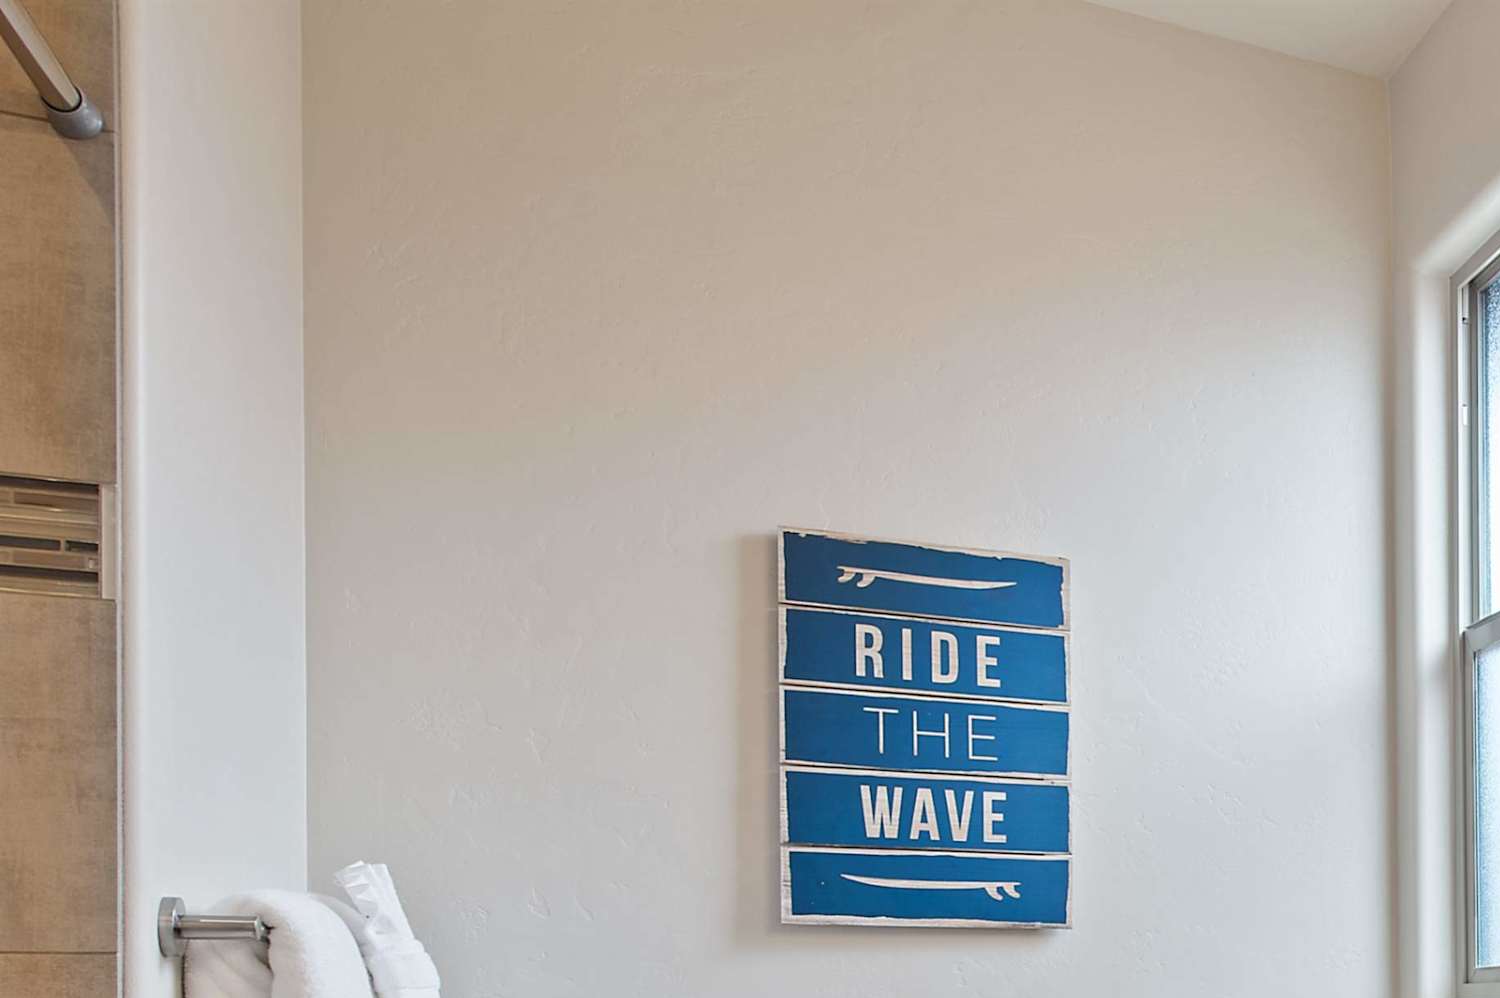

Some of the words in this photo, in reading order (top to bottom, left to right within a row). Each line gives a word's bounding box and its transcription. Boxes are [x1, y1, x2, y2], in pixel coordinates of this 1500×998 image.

[854, 623, 1001, 688] RIDE
[863, 706, 998, 761] THE
[860, 784, 1007, 844] WAVE
